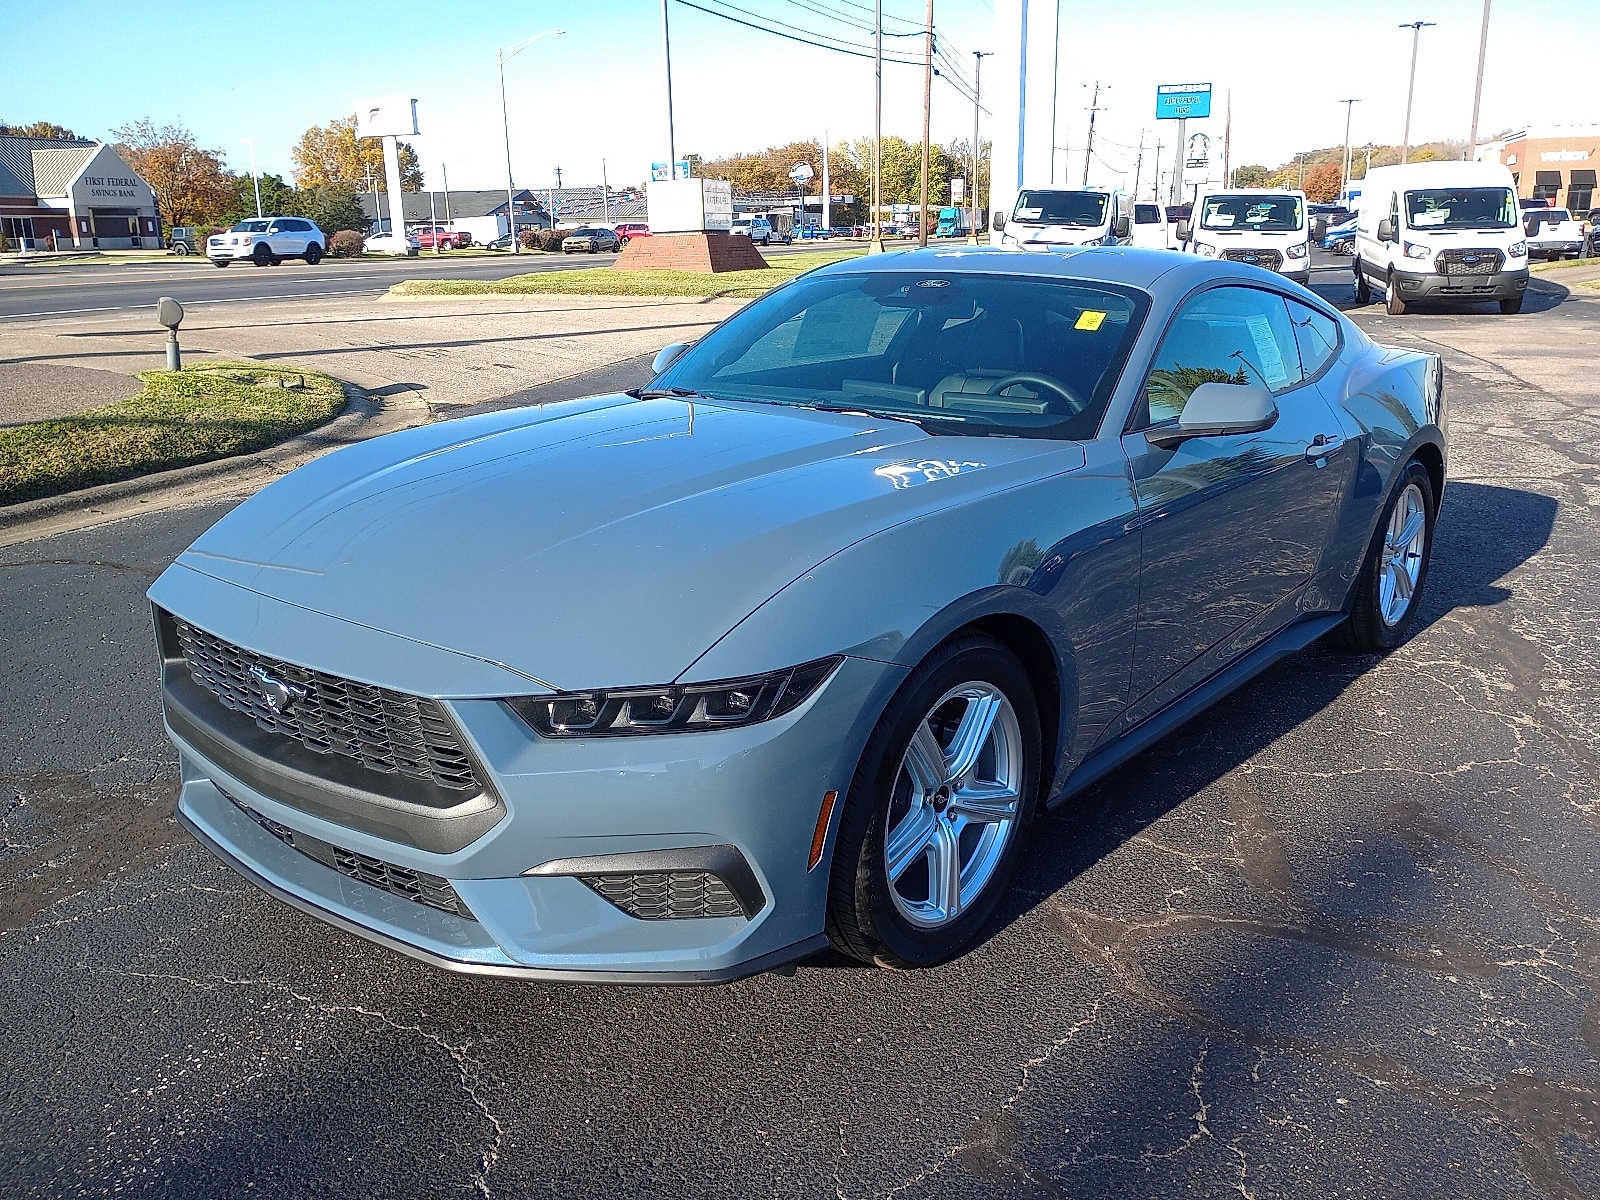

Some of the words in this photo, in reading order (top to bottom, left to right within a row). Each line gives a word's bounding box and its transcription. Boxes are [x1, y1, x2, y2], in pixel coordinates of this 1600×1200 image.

[85, 176, 105, 186] FIRST
[107, 177, 137, 187] FEDERAL
[91, 189, 117, 197] SAVINGS
[119, 189, 136, 198] BANK
